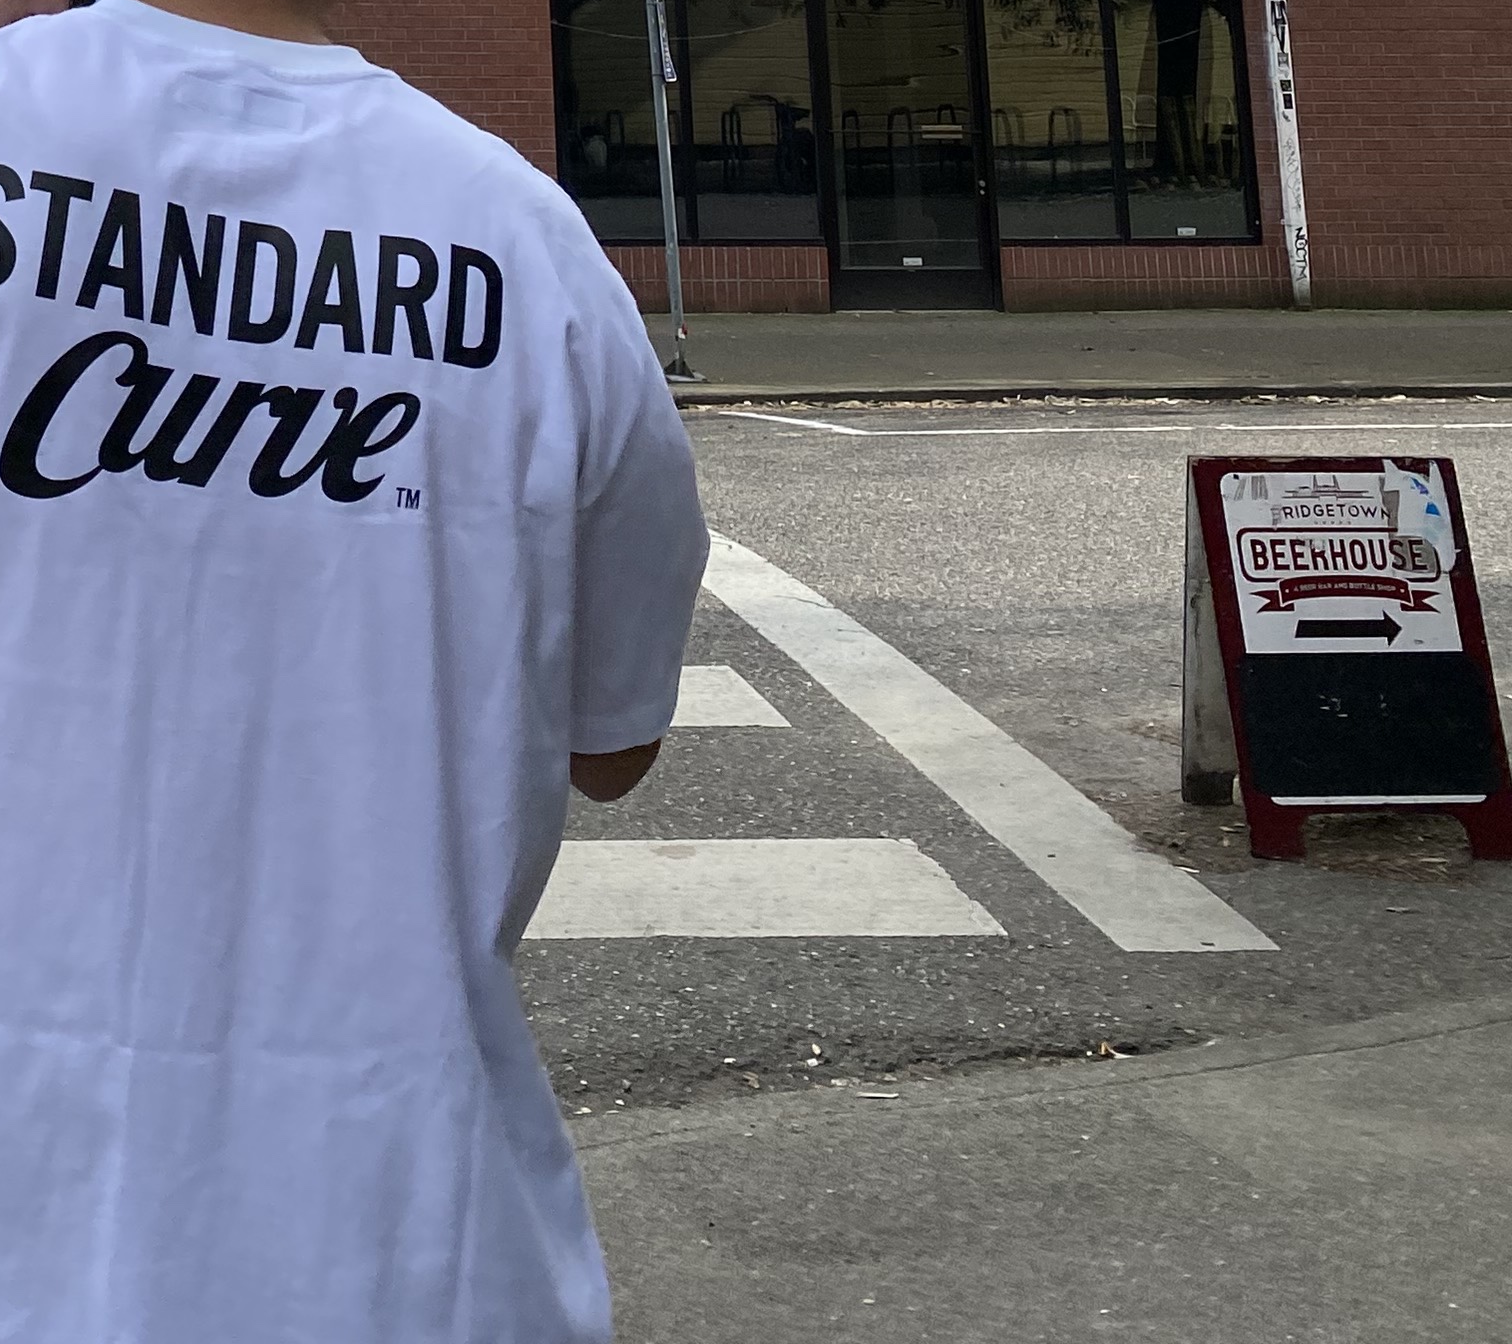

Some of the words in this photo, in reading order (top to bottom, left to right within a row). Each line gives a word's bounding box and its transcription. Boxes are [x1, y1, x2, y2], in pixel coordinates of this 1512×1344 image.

[396, 487, 420, 510] TM
[1272, 504, 1391, 520] RIDGETOWN
[1250, 538, 1429, 572] BEERHOUSE
